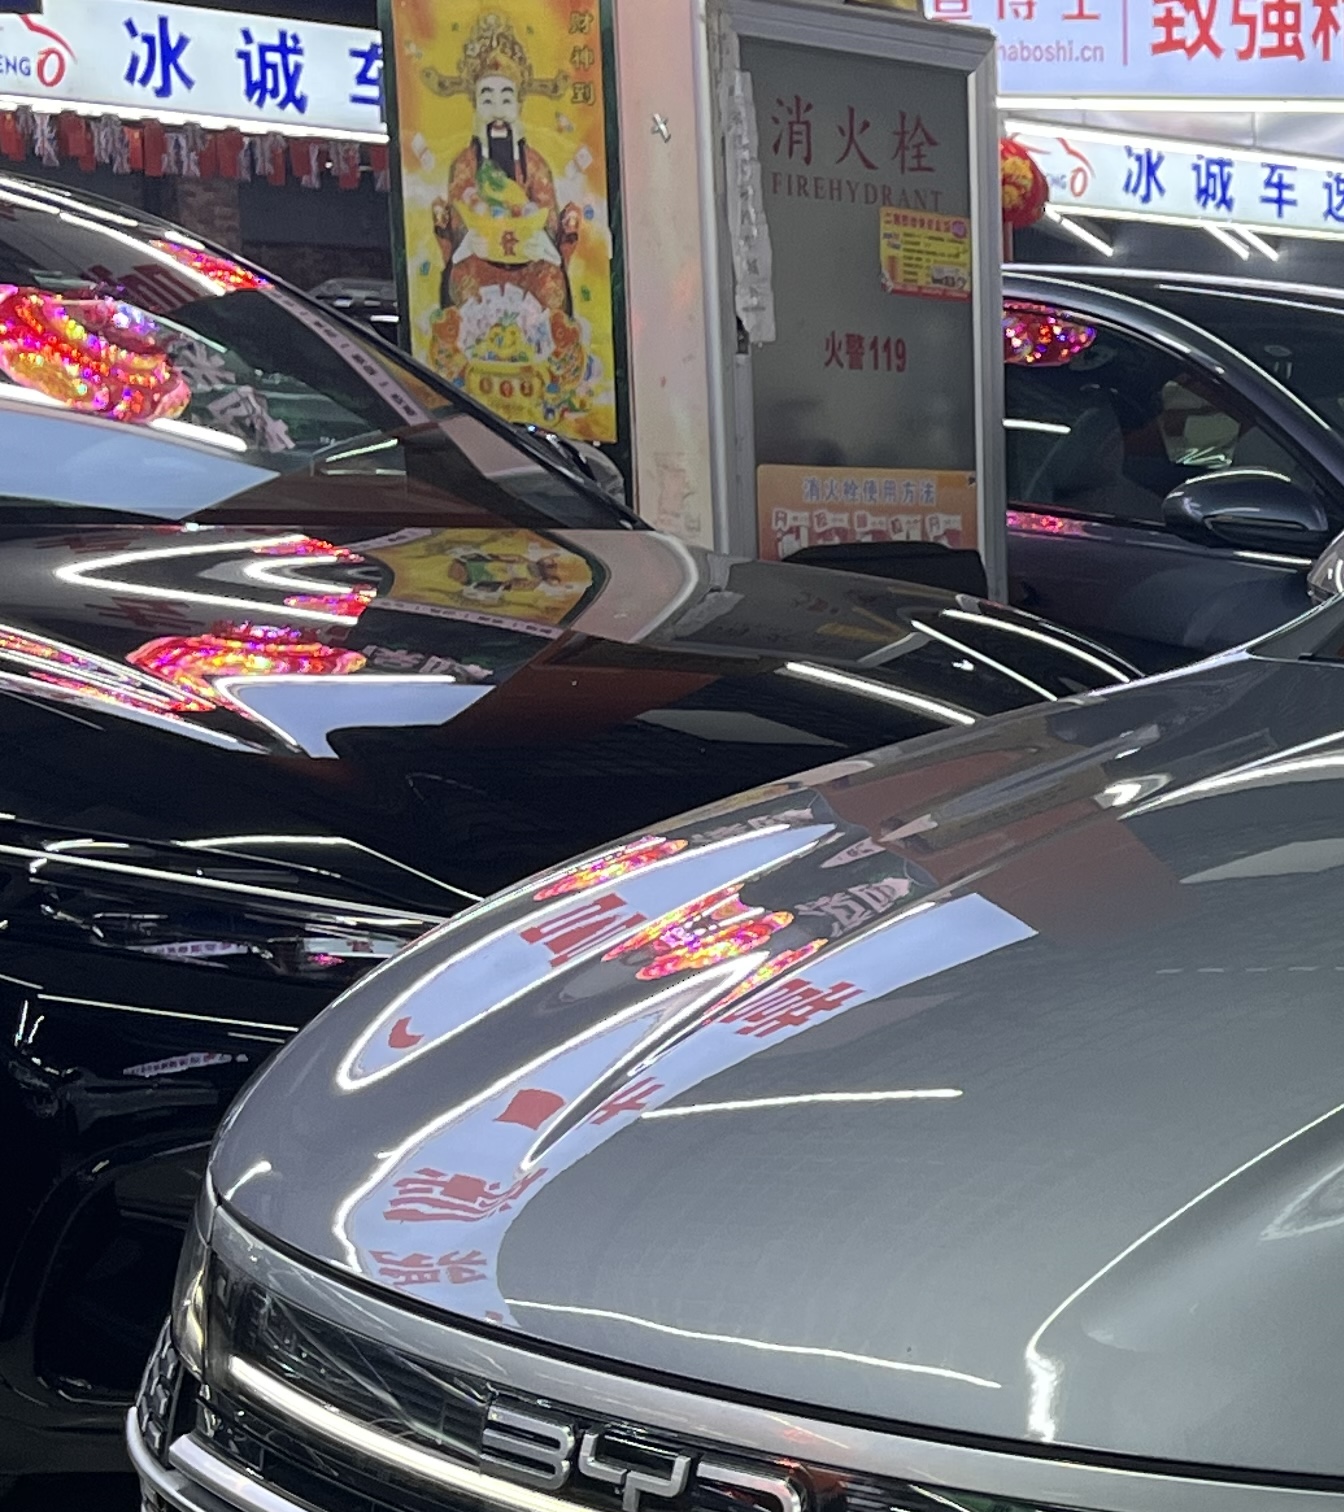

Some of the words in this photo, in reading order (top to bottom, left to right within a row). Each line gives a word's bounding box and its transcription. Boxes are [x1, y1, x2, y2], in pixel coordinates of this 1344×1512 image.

[771, 95, 940, 175] 消火栓
[824, 330, 907, 373] 火警119
[803, 476, 937, 506] 消火栓使用方法
